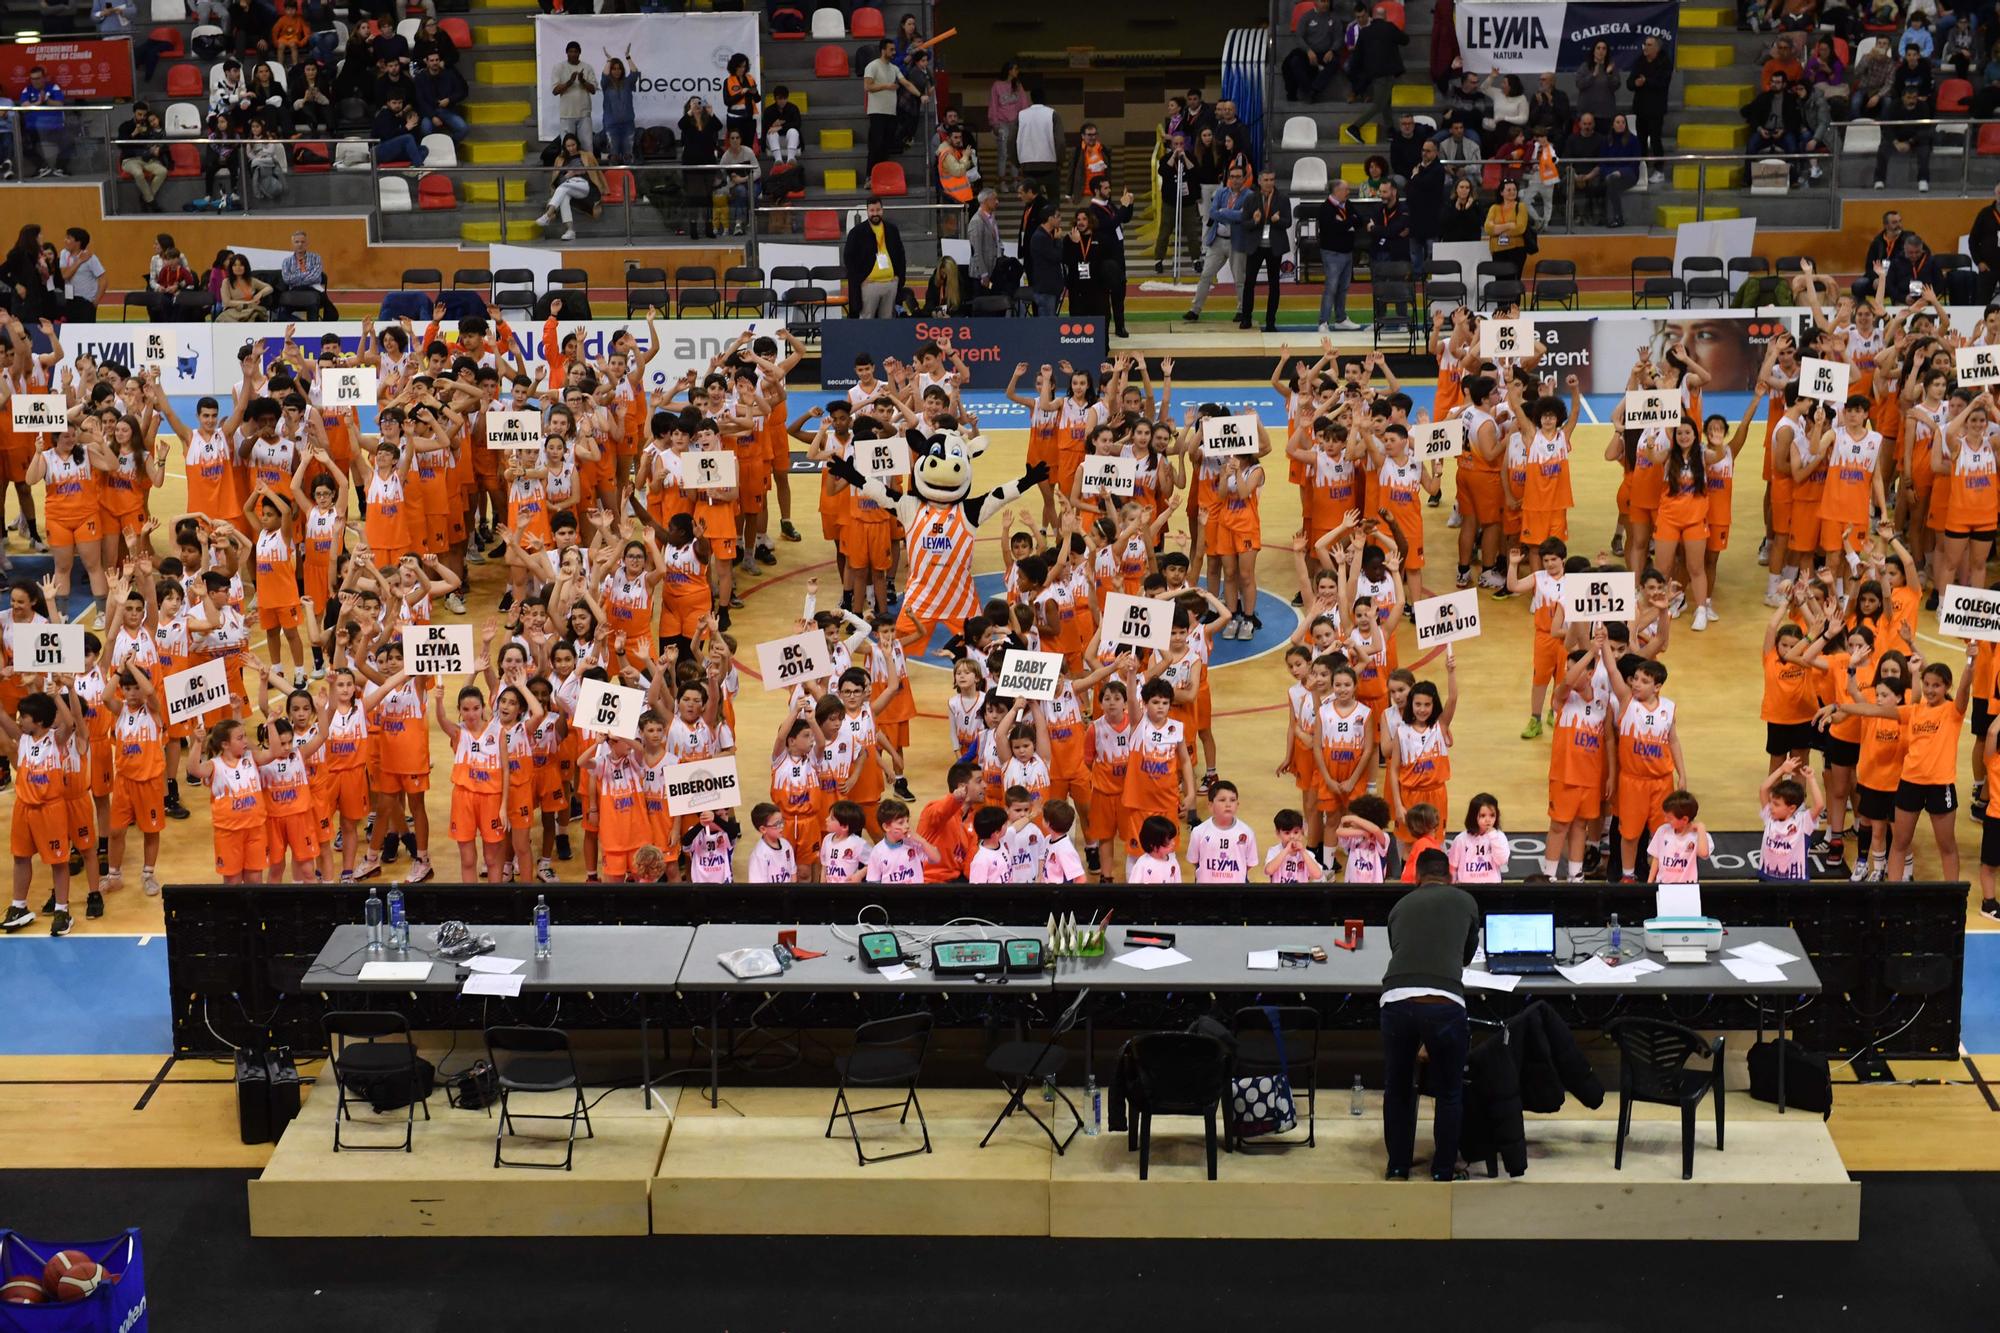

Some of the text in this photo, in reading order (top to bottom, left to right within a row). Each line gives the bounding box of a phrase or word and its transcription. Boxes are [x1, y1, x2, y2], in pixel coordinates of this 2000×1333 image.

[1467, 16, 1549, 49] LEYMA
[1570, 23, 1673, 42] GALEGA 100%
[1493, 52, 1523, 60] NATURA
[915, 323, 971, 341] See a
[1500, 326, 1514, 337] BC
[150, 335, 161, 346] BC
[1060, 336, 1095, 344] Securitas
[1500, 340, 1514, 350] 09
[77, 342, 145, 369] LEYM
[146, 347, 165, 359] U15
[1977, 353, 1992, 365] BC
[1818, 367, 1832, 380] BC
[1961, 366, 2000, 379] LEYMA
[342, 375, 356, 386] BC
[1814, 381, 1834, 393] U16
[338, 386, 360, 399] U14
[33, 402, 45, 412] BC
[1647, 398, 1659, 408] BC
[15, 415, 65, 425] LEYMA U15
[1627, 409, 1678, 421] LEYMA U16
[507, 419, 520, 429] BC
[1223, 423, 1237, 435] BC
[489, 432, 539, 442] LEYMA U14
[1432, 428, 1445, 440] BC
[1209, 436, 1246, 449] LEYMA
[1426, 440, 1451, 454] 2010
[874, 446, 889, 457] BC
[701, 458, 715, 469] BC
[872, 458, 894, 470] U13
[1104, 464, 1116, 474] BC
[1084, 476, 1132, 488] LEYMA U13
[923, 537, 952, 550] LEYMA
[1591, 582, 1609, 595] BC
[1440, 604, 1454, 618] BC
[1575, 598, 1624, 613] U11-12
[1129, 605, 1148, 620] BC
[1122, 621, 1150, 638] U10
[1419, 615, 1477, 639] LEYMA U10
[40, 633, 59, 647] BC
[429, 628, 446, 640] BC
[36, 650, 62, 664] U11
[416, 644, 460, 657] LEYMA
[783, 644, 802, 661] BC
[416, 660, 462, 673] U11-12
[778, 658, 814, 679] 2014
[1014, 659, 1048, 675] BABY
[189, 675, 204, 690] BC
[1001, 675, 1053, 692] BASQUET
[170, 684, 227, 714] LEYMA U11
[602, 692, 620, 708] BC
[597, 709, 616, 725] U9
[1338, 722, 1348, 733] 23
[1152, 731, 1162, 743] 33
[669, 775, 736, 797] BIBERONES
[1219, 838, 1229, 849] 18
[700, 854, 725, 866] LEYMA
[1207, 859, 1240, 872] LEYMA
[1466, 860, 1493, 872] LEYMA
